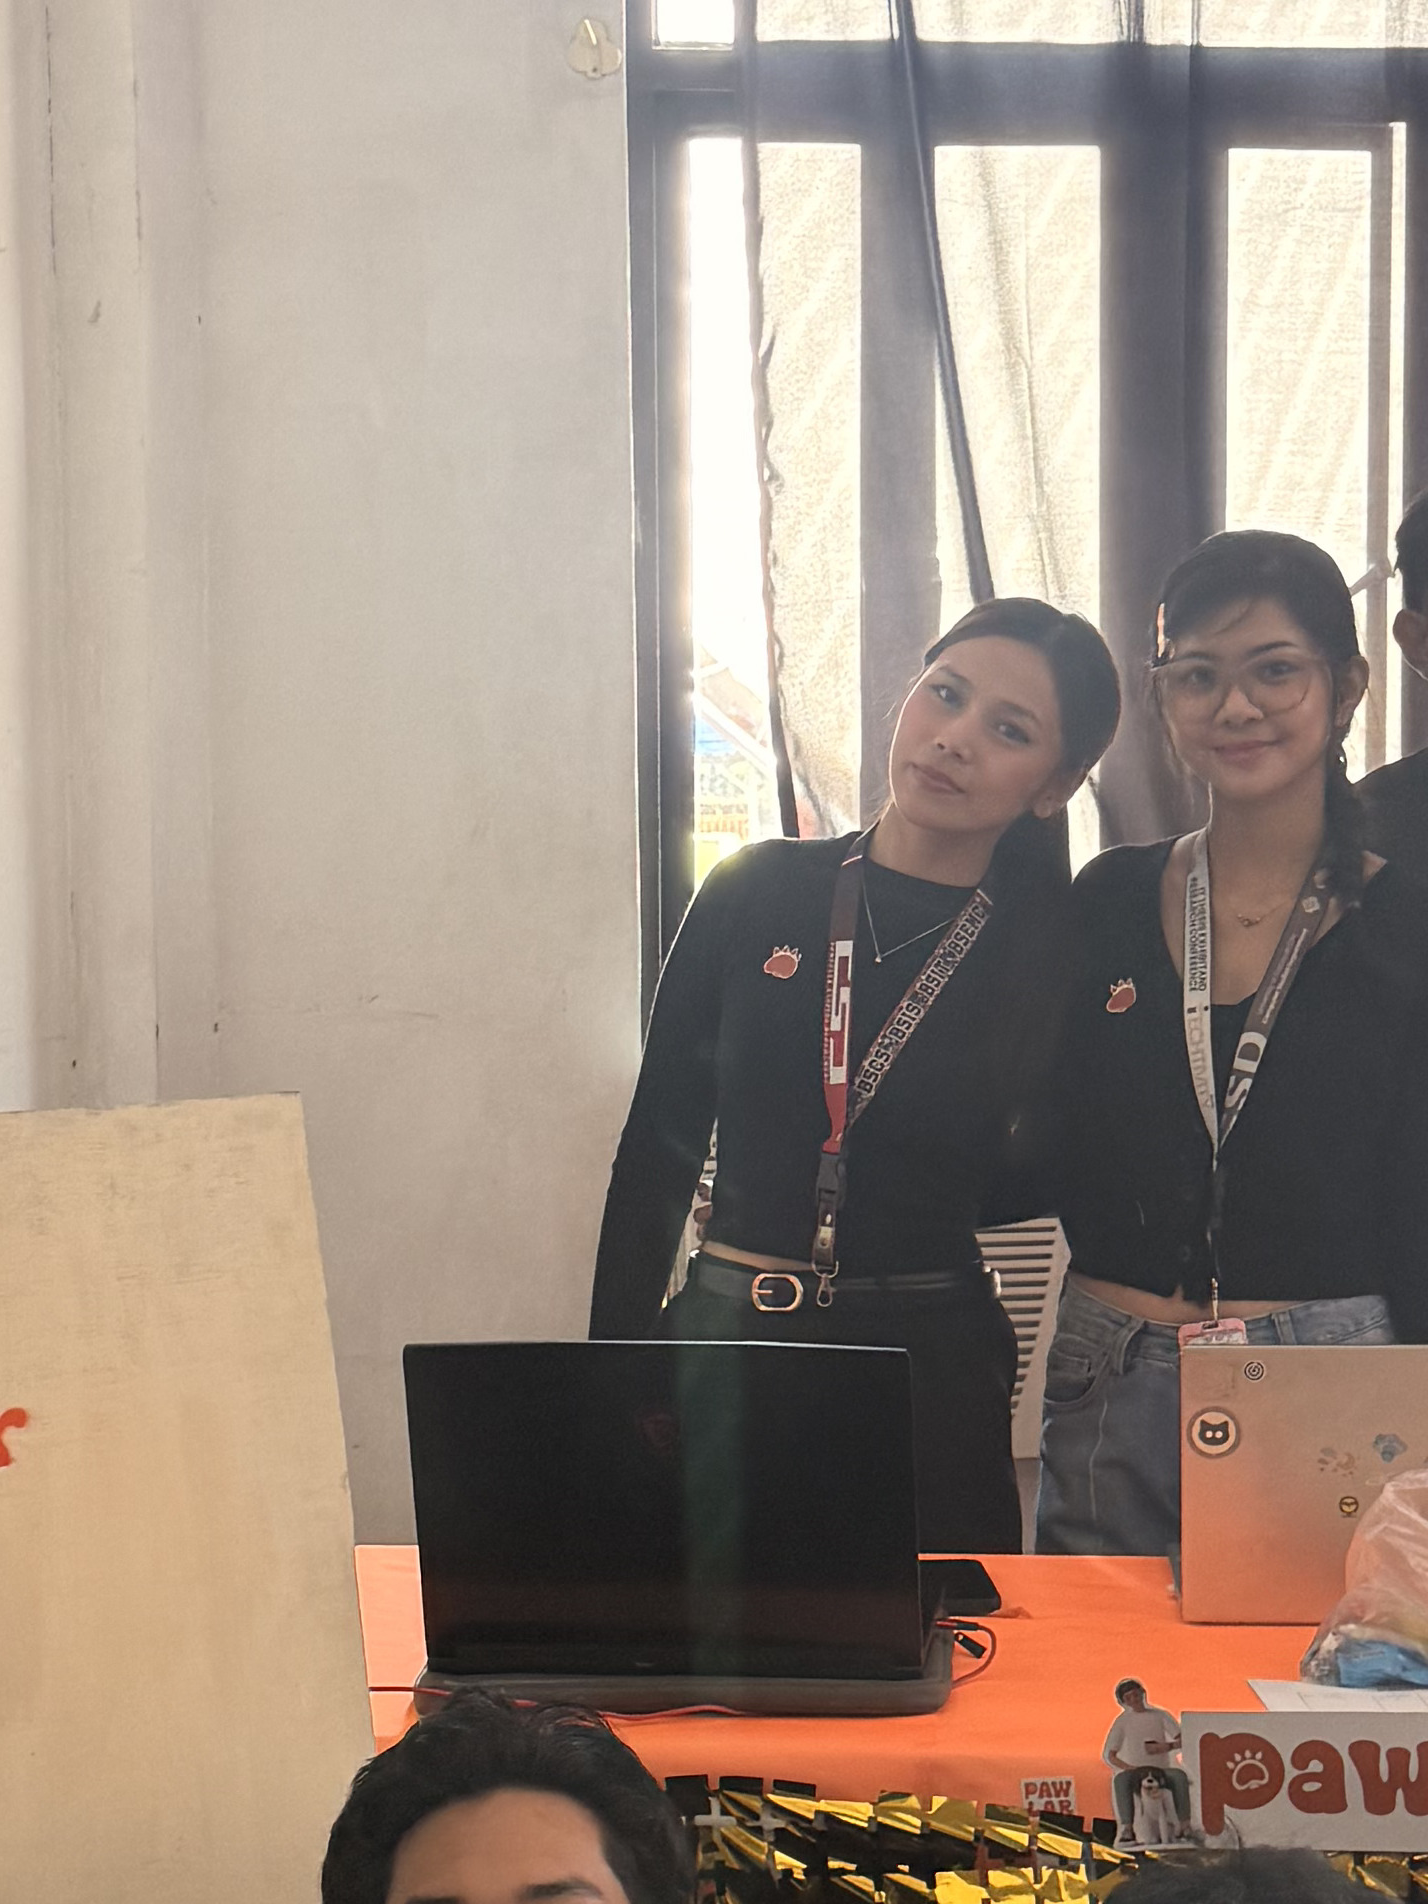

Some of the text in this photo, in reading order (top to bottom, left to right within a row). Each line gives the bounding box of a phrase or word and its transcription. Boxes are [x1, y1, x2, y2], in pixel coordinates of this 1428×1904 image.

[856, 1047, 892, 1097] BSCS
[888, 1001, 923, 1044] BSIS
[1024, 1780, 1072, 1800] PAW
